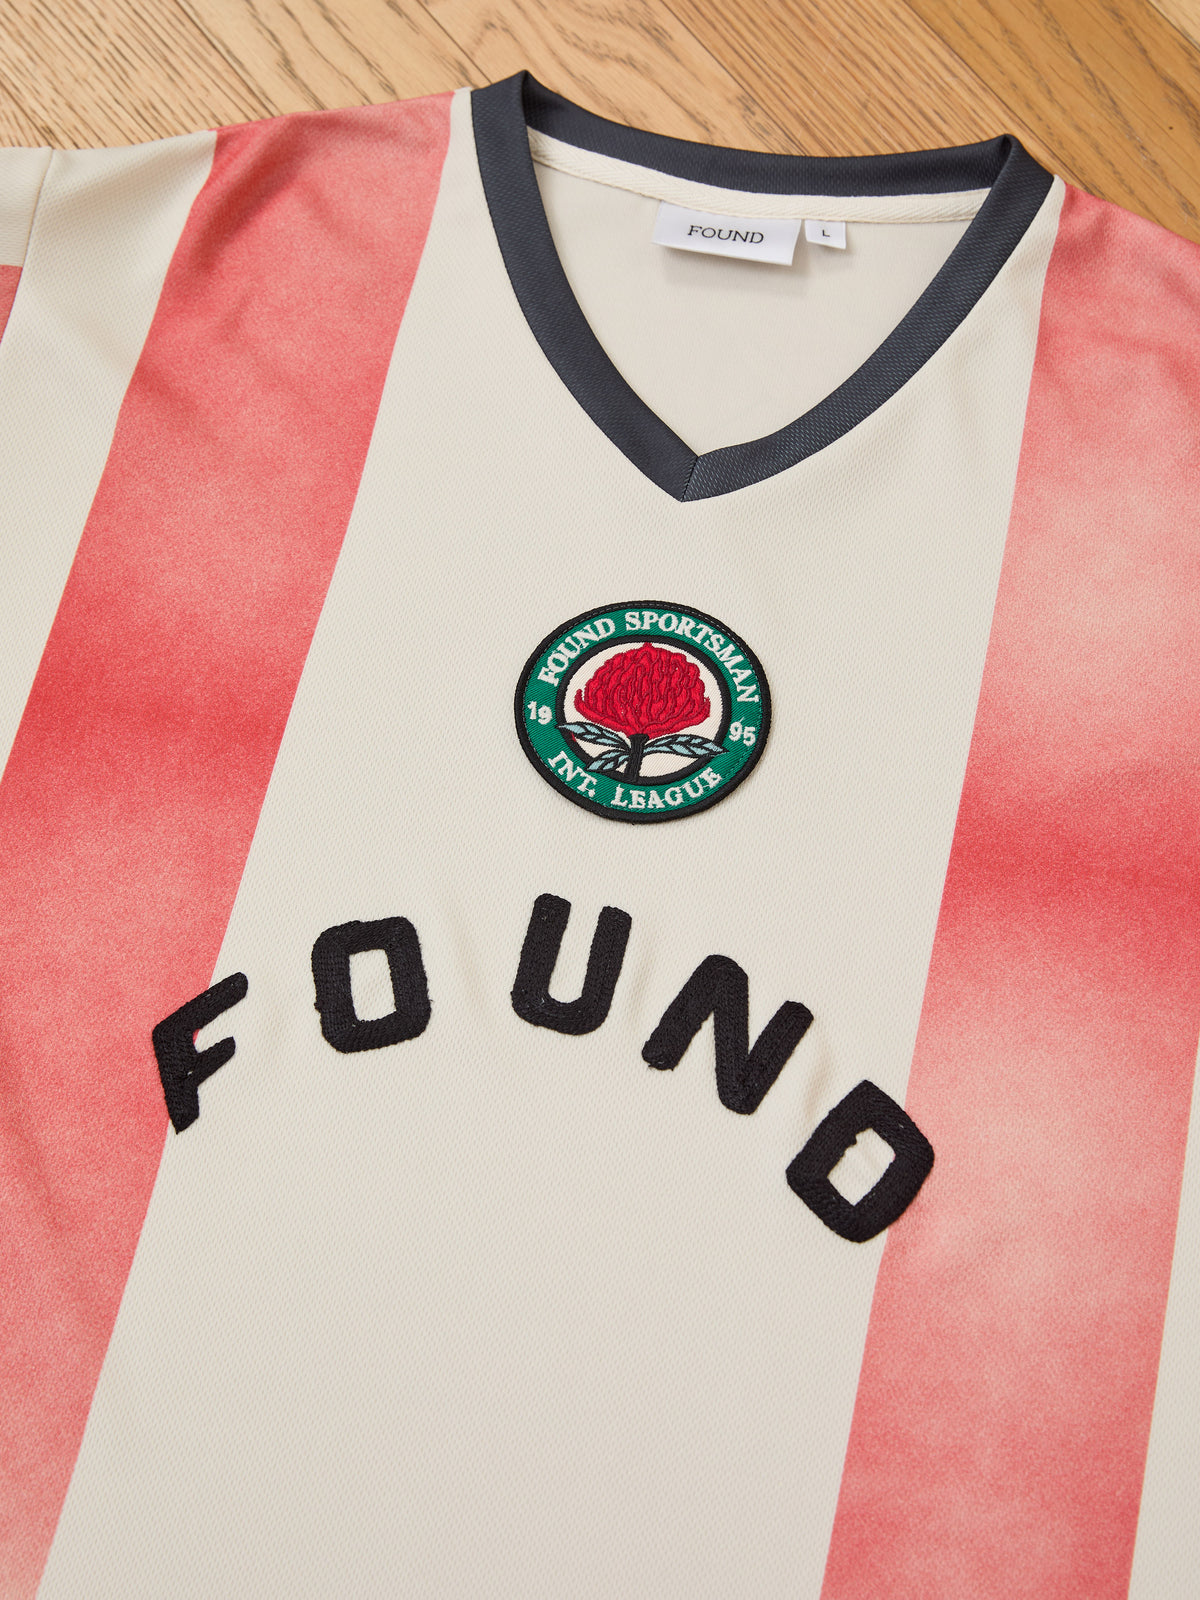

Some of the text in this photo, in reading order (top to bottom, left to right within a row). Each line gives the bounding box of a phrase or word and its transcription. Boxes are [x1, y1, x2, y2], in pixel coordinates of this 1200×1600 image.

[687, 225, 764, 244] FOUND
[821, 229, 831, 238] L
[538, 611, 759, 703] FOUND SPORTSMAN
[527, 701, 756, 746] 19 95
[548, 751, 722, 809] INT. LEAGUE
[152, 893, 935, 1243] FOUND
